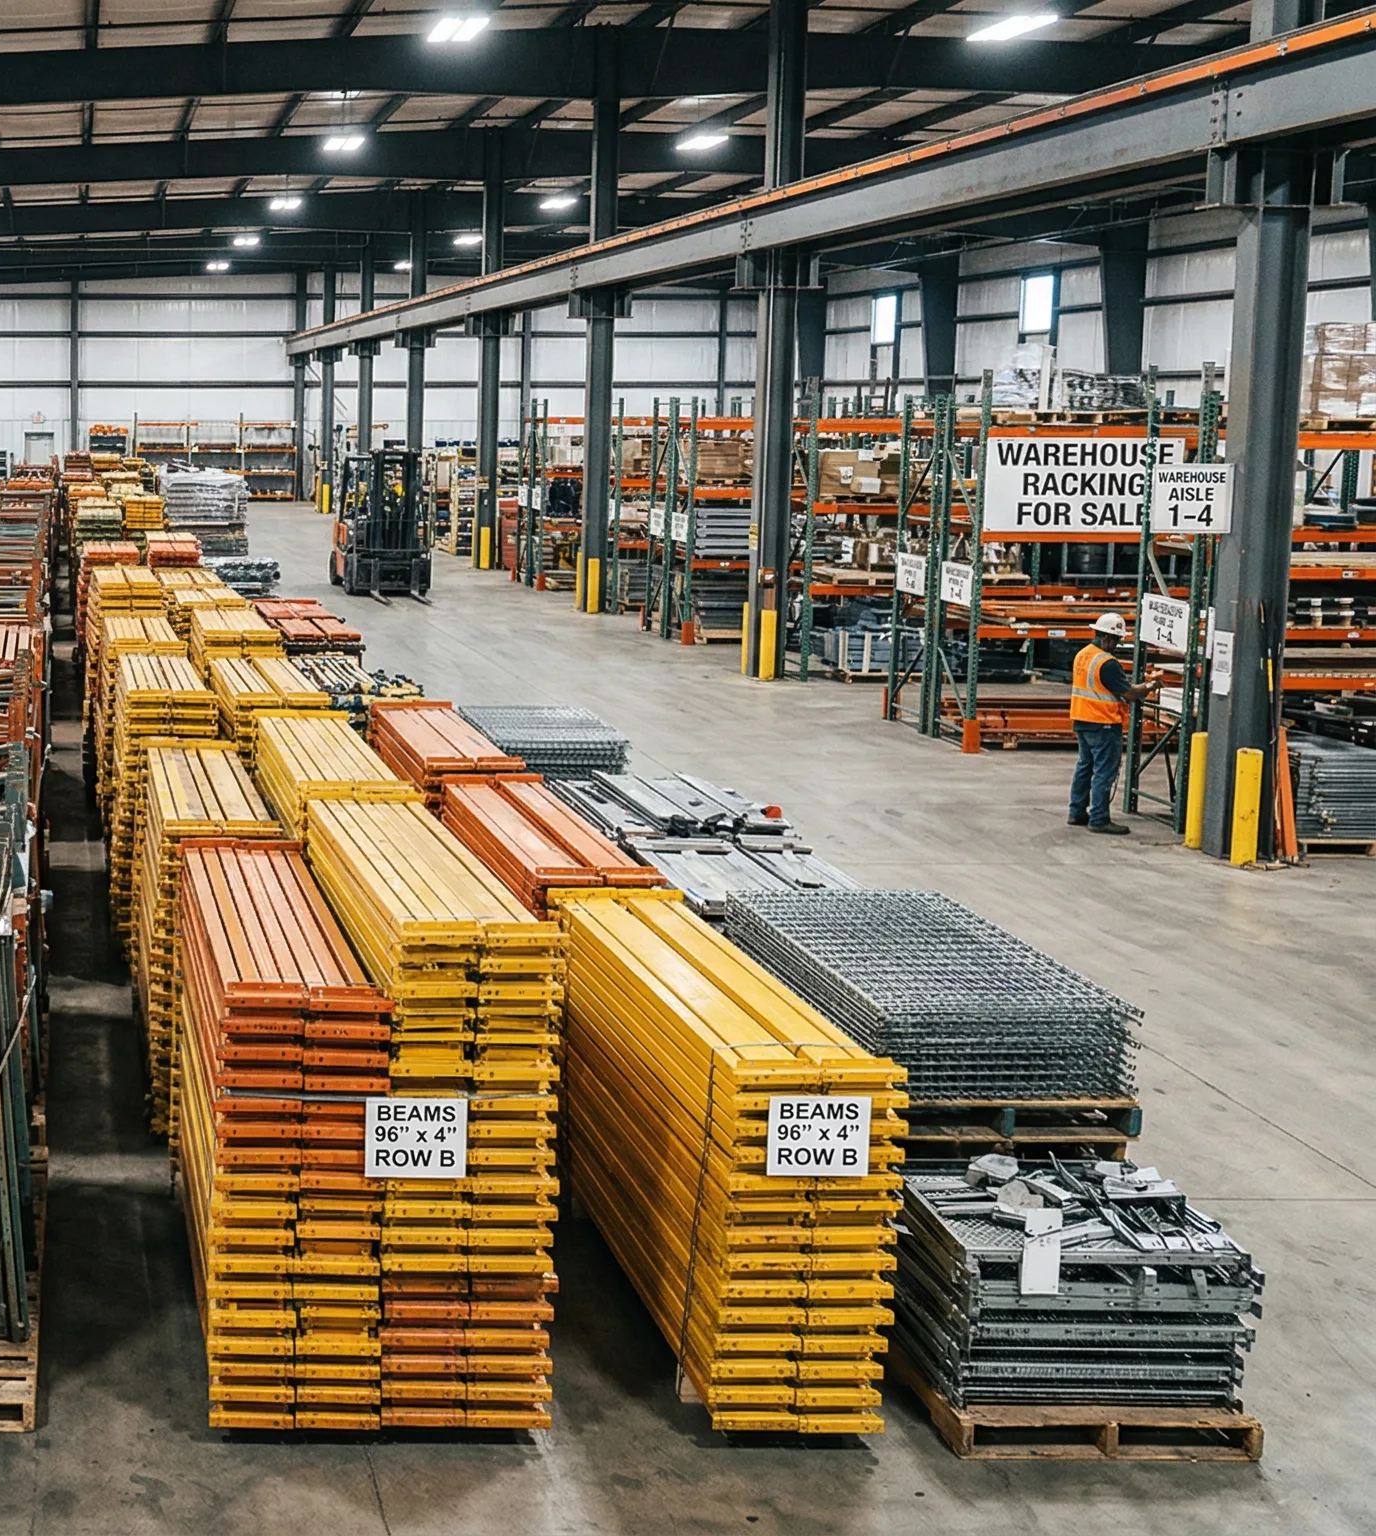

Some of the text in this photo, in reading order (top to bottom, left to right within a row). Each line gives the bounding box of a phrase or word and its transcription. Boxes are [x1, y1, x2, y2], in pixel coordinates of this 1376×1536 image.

[1023, 472, 1145, 497] RACKING
[1158, 471, 1227, 484] WAREHOUSE
[1168, 487, 1214, 502] AISLE
[1016, 502, 1071, 526] FOR
[1168, 504, 1213, 527] 1-4
[377, 1105, 456, 1122] BEAMS
[780, 1103, 859, 1120] BEAMS
[416, 1130, 428, 1142] x
[818, 1128, 830, 1141] x
[375, 1149, 455, 1167] ROW B
[777, 1148, 858, 1166] ROW B
